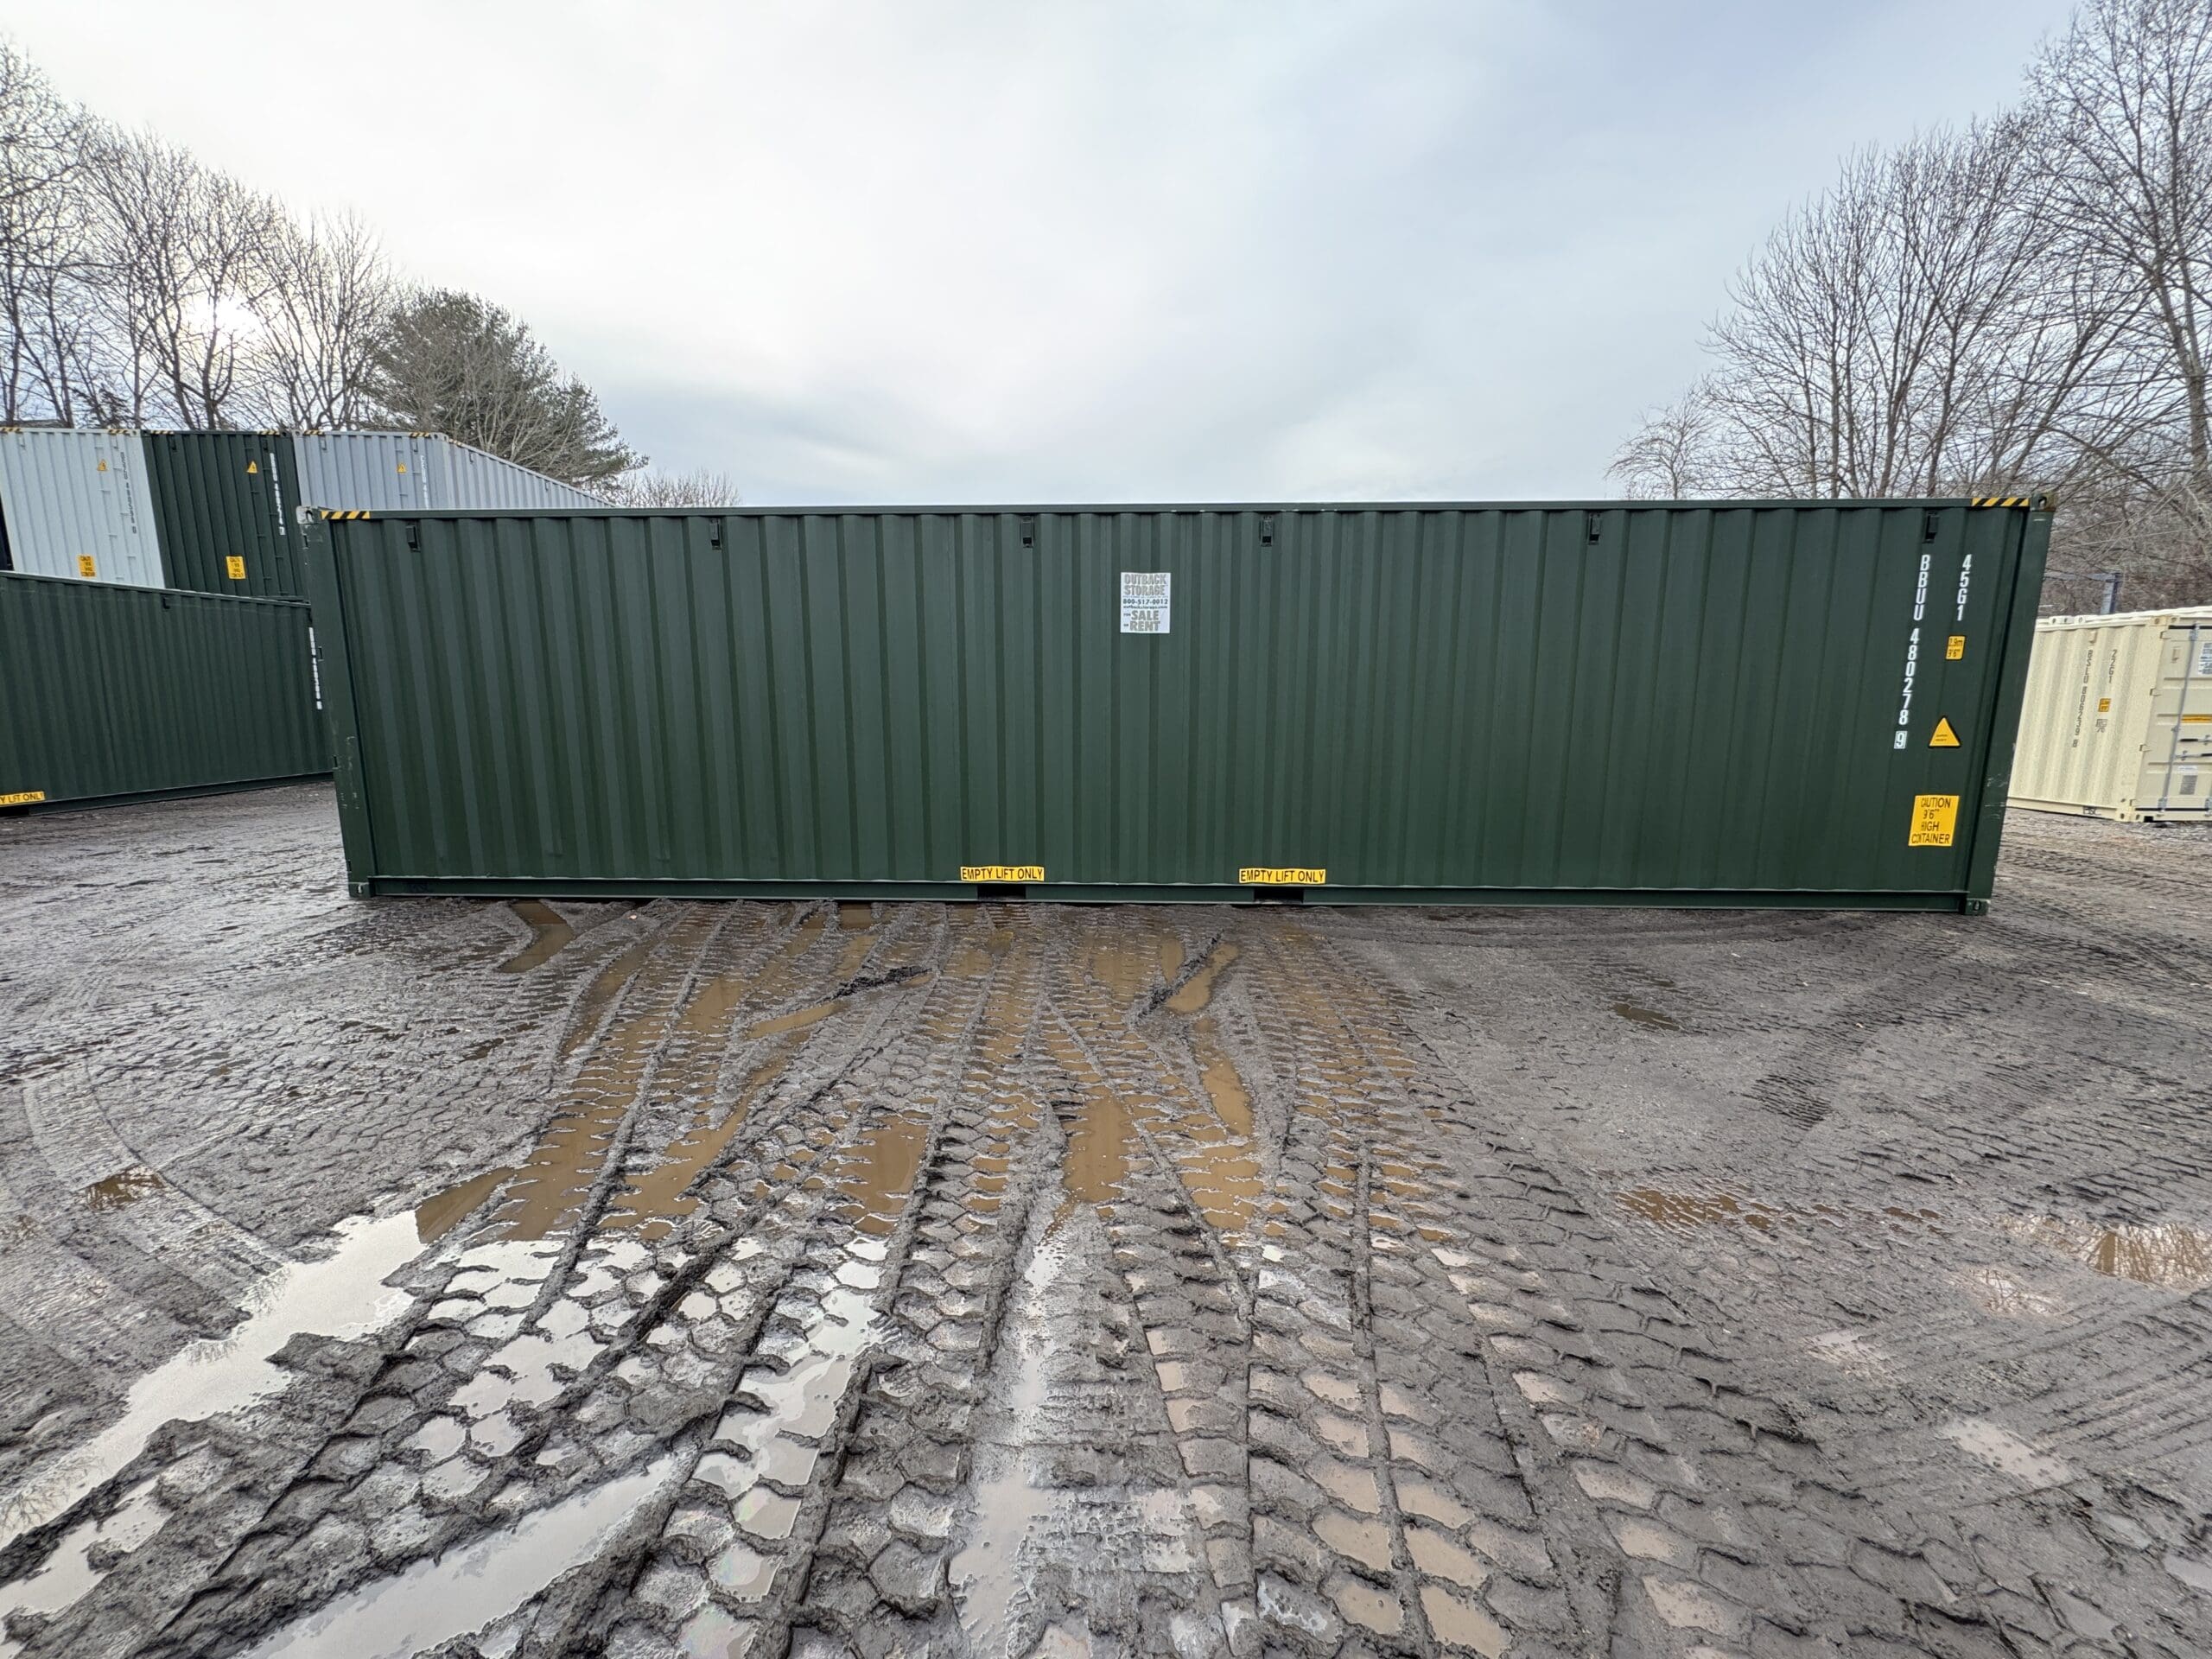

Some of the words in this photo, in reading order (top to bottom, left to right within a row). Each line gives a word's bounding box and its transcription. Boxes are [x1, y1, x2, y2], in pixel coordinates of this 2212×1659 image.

[1124, 574, 1166, 584] OUTBACK
[1124, 585, 1165, 595] STORAGE
[1913, 554, 1931, 621] BBUU
[1956, 554, 1972, 621] 45G1
[1131, 610, 1159, 620] SALE
[1130, 621, 1160, 631] RENT
[1898, 627, 1920, 726] 480278
[1894, 730, 1907, 748] 9
[962, 867, 993, 880] EMPTY
[996, 868, 1015, 879] LIFT
[1018, 868, 1042, 879] ONLY
[1241, 869, 1272, 881] EMPTY
[1275, 870, 1295, 881] LIFT
[1298, 870, 1325, 882] ONLY
